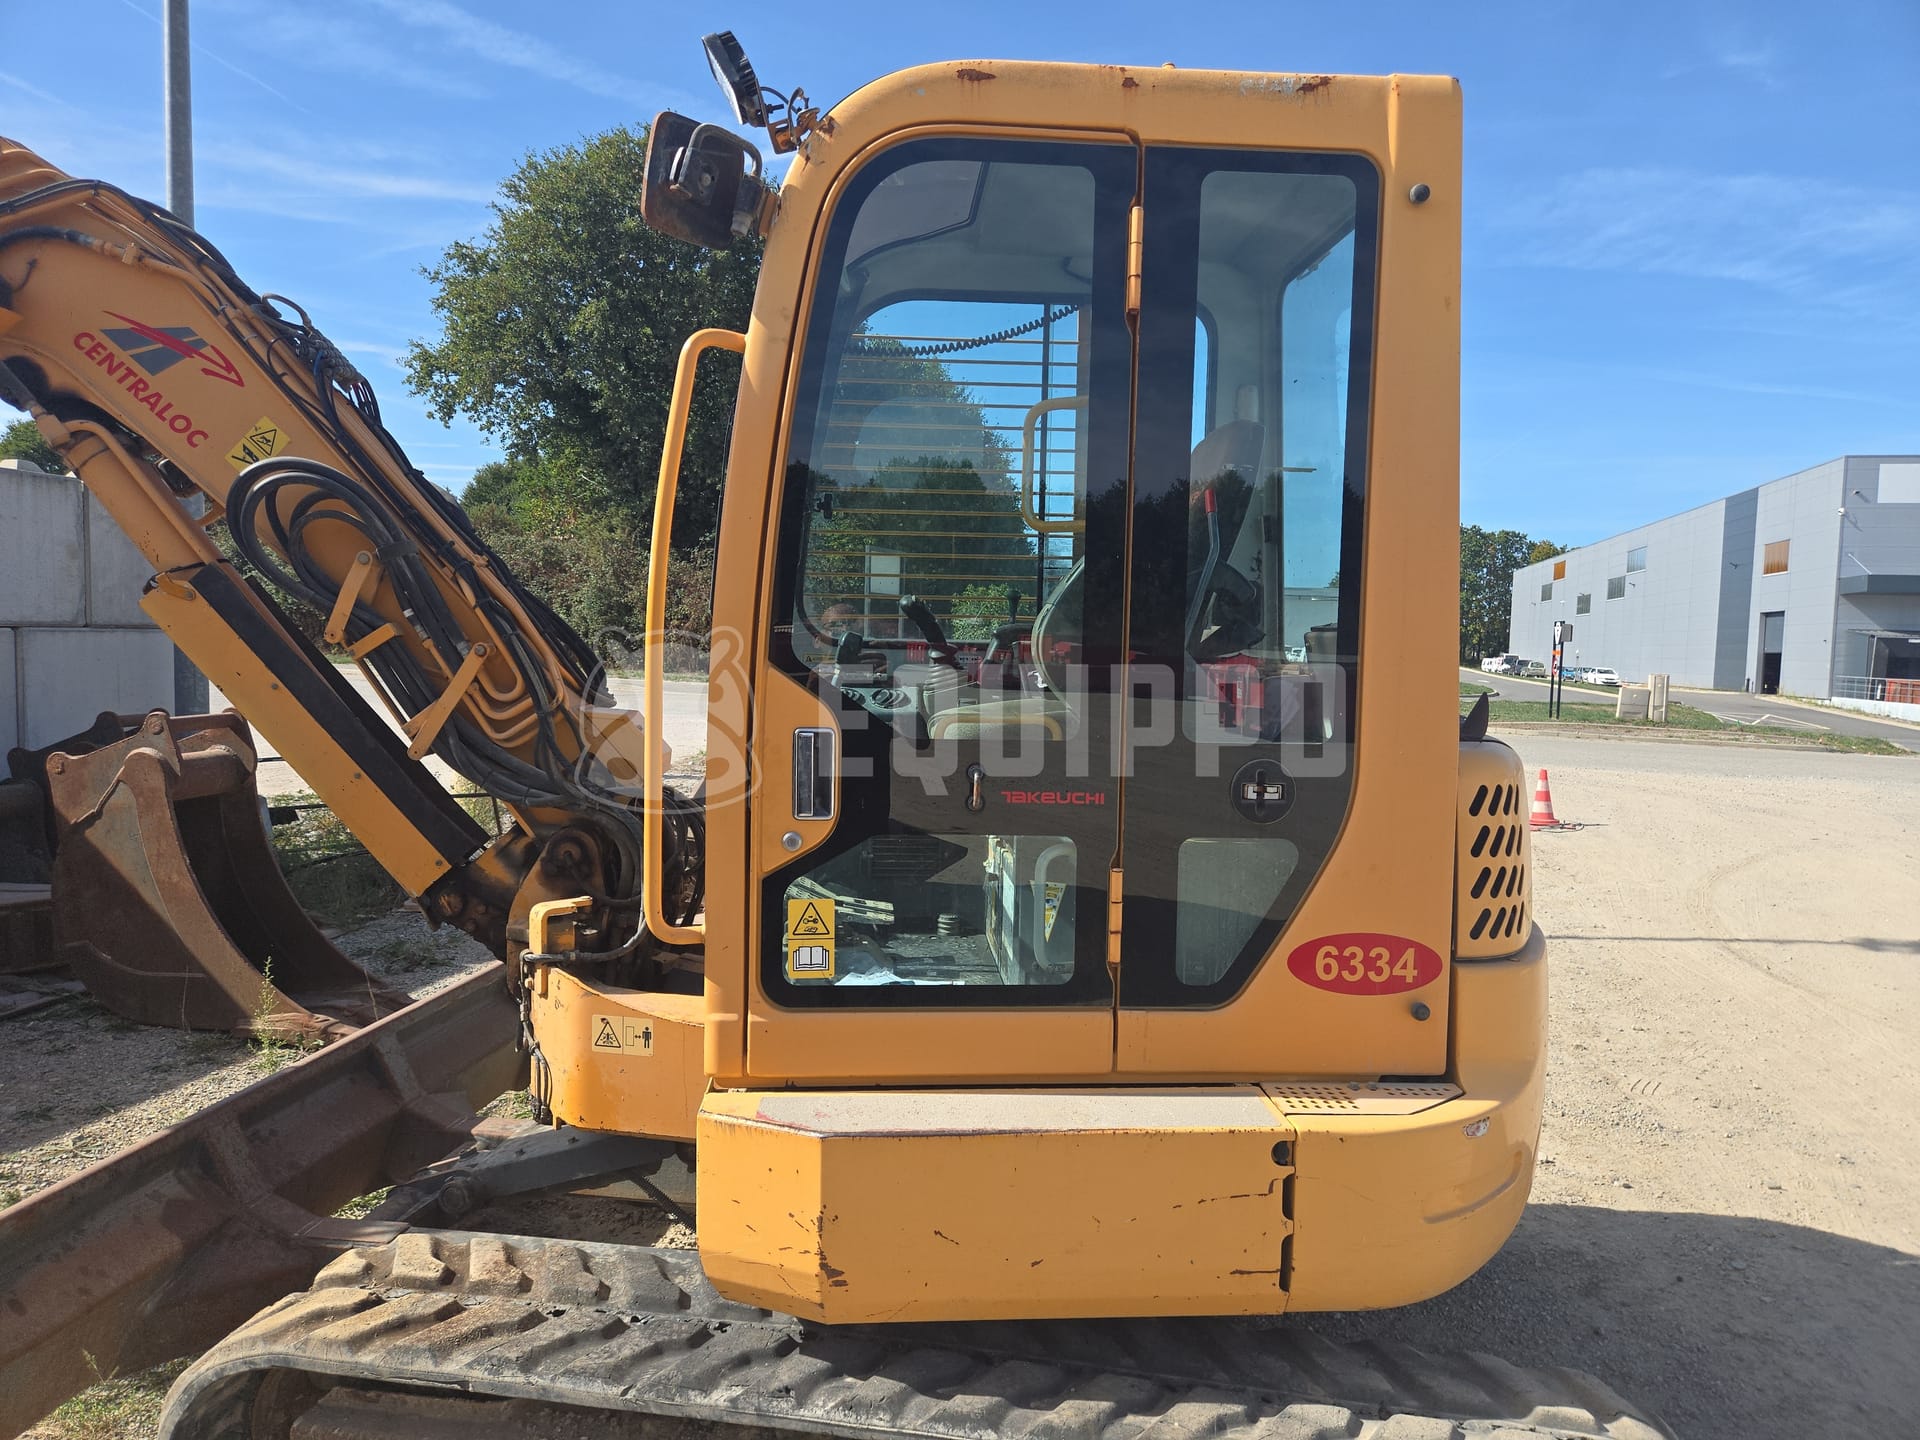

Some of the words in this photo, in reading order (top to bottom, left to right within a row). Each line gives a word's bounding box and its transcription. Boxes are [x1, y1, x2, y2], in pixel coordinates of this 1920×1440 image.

[73, 332, 209, 449] CENTRALOC
[1000, 791, 1105, 805] TAKEUCHI
[1315, 945, 1418, 983] 6334
